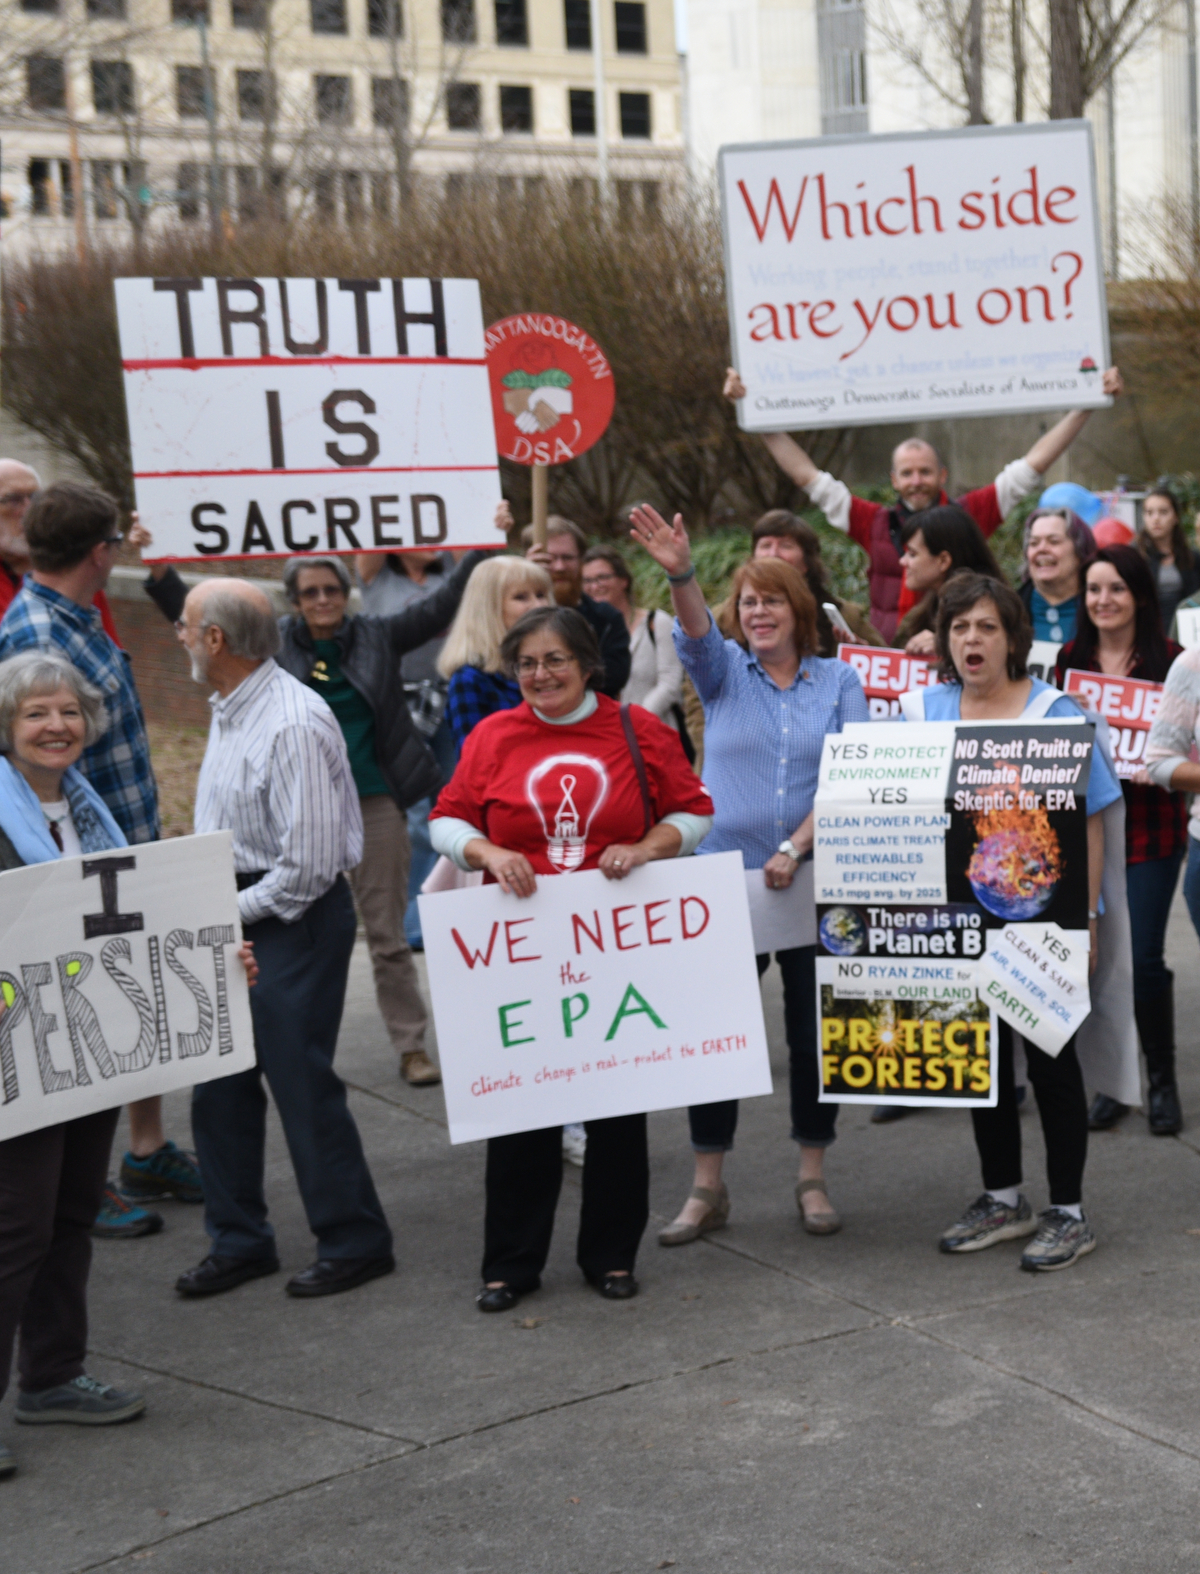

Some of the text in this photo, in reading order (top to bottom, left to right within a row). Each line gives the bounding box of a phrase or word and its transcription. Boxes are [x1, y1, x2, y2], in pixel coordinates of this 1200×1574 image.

[737, 164, 1079, 243] Which side
[154, 278, 447, 358] TRUTH
[747, 251, 1083, 361] are you on?
[755, 376, 1078, 413] Chattanooga Democratic Socialists of America
[266, 390, 379, 468] IS
[192, 494, 447, 554] SACRED
[849, 653, 938, 692] REJE
[1079, 680, 1165, 722] REJE
[830, 744, 947, 760] YES PROTECT
[955, 740, 979, 759] NO
[982, 739, 1023, 759] Scott
[1027, 738, 1069, 759] Pruitt
[1072, 743, 1091, 759] or
[828, 767, 941, 780] ENVIRONMENT
[957, 763, 1081, 785] Climate Denier/
[868, 787, 908, 804] YES
[954, 790, 1077, 815] Skeptic for EPA
[818, 815, 948, 828] CLEAN POWER PLAN
[818, 835, 946, 846] PARIS CLIMATE TREATY
[835, 853, 924, 865] RENEWABLES
[843, 871, 917, 883] EFFICIENCY
[82, 855, 144, 940] I
[822, 888, 942, 901] 54.5 mpg avg. by 2025
[867, 908, 981, 929] There is no
[451, 895, 710, 970] WE NEED
[868, 929, 982, 955] Planet B
[1041, 931, 1071, 962] YES
[560, 961, 591, 985] the
[838, 963, 972, 981] NO RYAN ZINKE for
[1005, 930, 1040, 965] CLEAN
[1049, 969, 1077, 995] SAFE
[898, 986, 929, 998] OUR
[933, 987, 971, 999] LAND
[987, 980, 1040, 1030] EARTH
[0, 924, 236, 1106] PERSIST
[1048, 1000, 1072, 1024] SOIL
[535, 1066, 577, 1083] change
[582, 1060, 591, 1074] is
[596, 1055, 618, 1071] real
[634, 1048, 673, 1067] protect
[680, 1044, 696, 1057] the
[701, 1035, 747, 1056] EARTH
[823, 1056, 990, 1092] FORESTS
